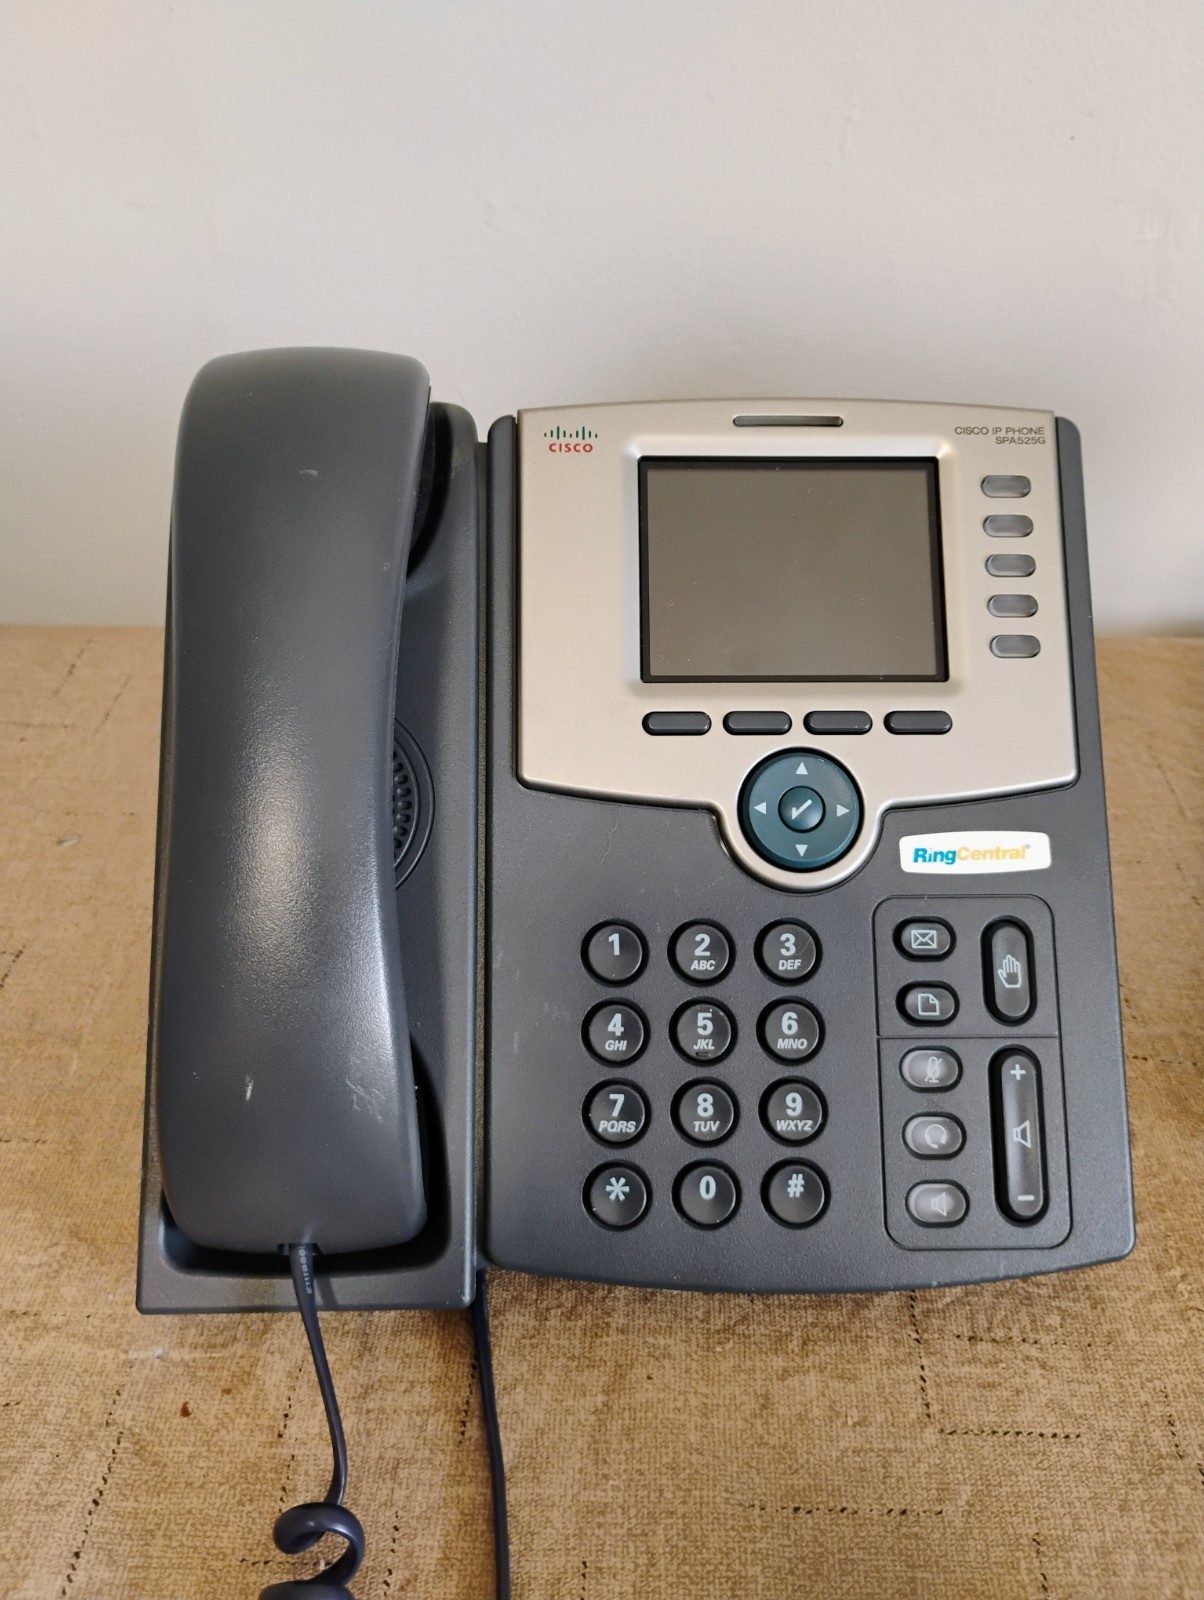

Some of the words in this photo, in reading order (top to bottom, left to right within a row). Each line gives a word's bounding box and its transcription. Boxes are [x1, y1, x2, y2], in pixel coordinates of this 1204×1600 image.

[955, 426, 989, 435] CISCO
[992, 427, 1002, 435] IP
[1005, 427, 1045, 435] PHONE
[549, 443, 593, 453] CISCO
[995, 436, 1046, 444] SPA525G
[608, 933, 620, 955] 1
[694, 933, 711, 957] 2
[779, 933, 796, 957] 3
[690, 959, 715, 971] ABC
[778, 959, 802, 971] DEF
[607, 1013, 625, 1036] 4
[697, 1012, 714, 1035] 5
[781, 1012, 799, 1036] 6
[604, 1039, 628, 1051] GHI
[693, 1039, 715, 1050] JKL
[776, 1038, 807, 1050] MNO
[609, 1093, 625, 1117] 7
[697, 1093, 714, 1118] 8
[785, 1093, 803, 1117] 9
[598, 1120, 637, 1133] PQRS
[693, 1120, 720, 1133] TUV
[776, 1119, 813, 1132] WXYZ
[699, 1176, 716, 1200] 0
[787, 1173, 805, 1198] #
